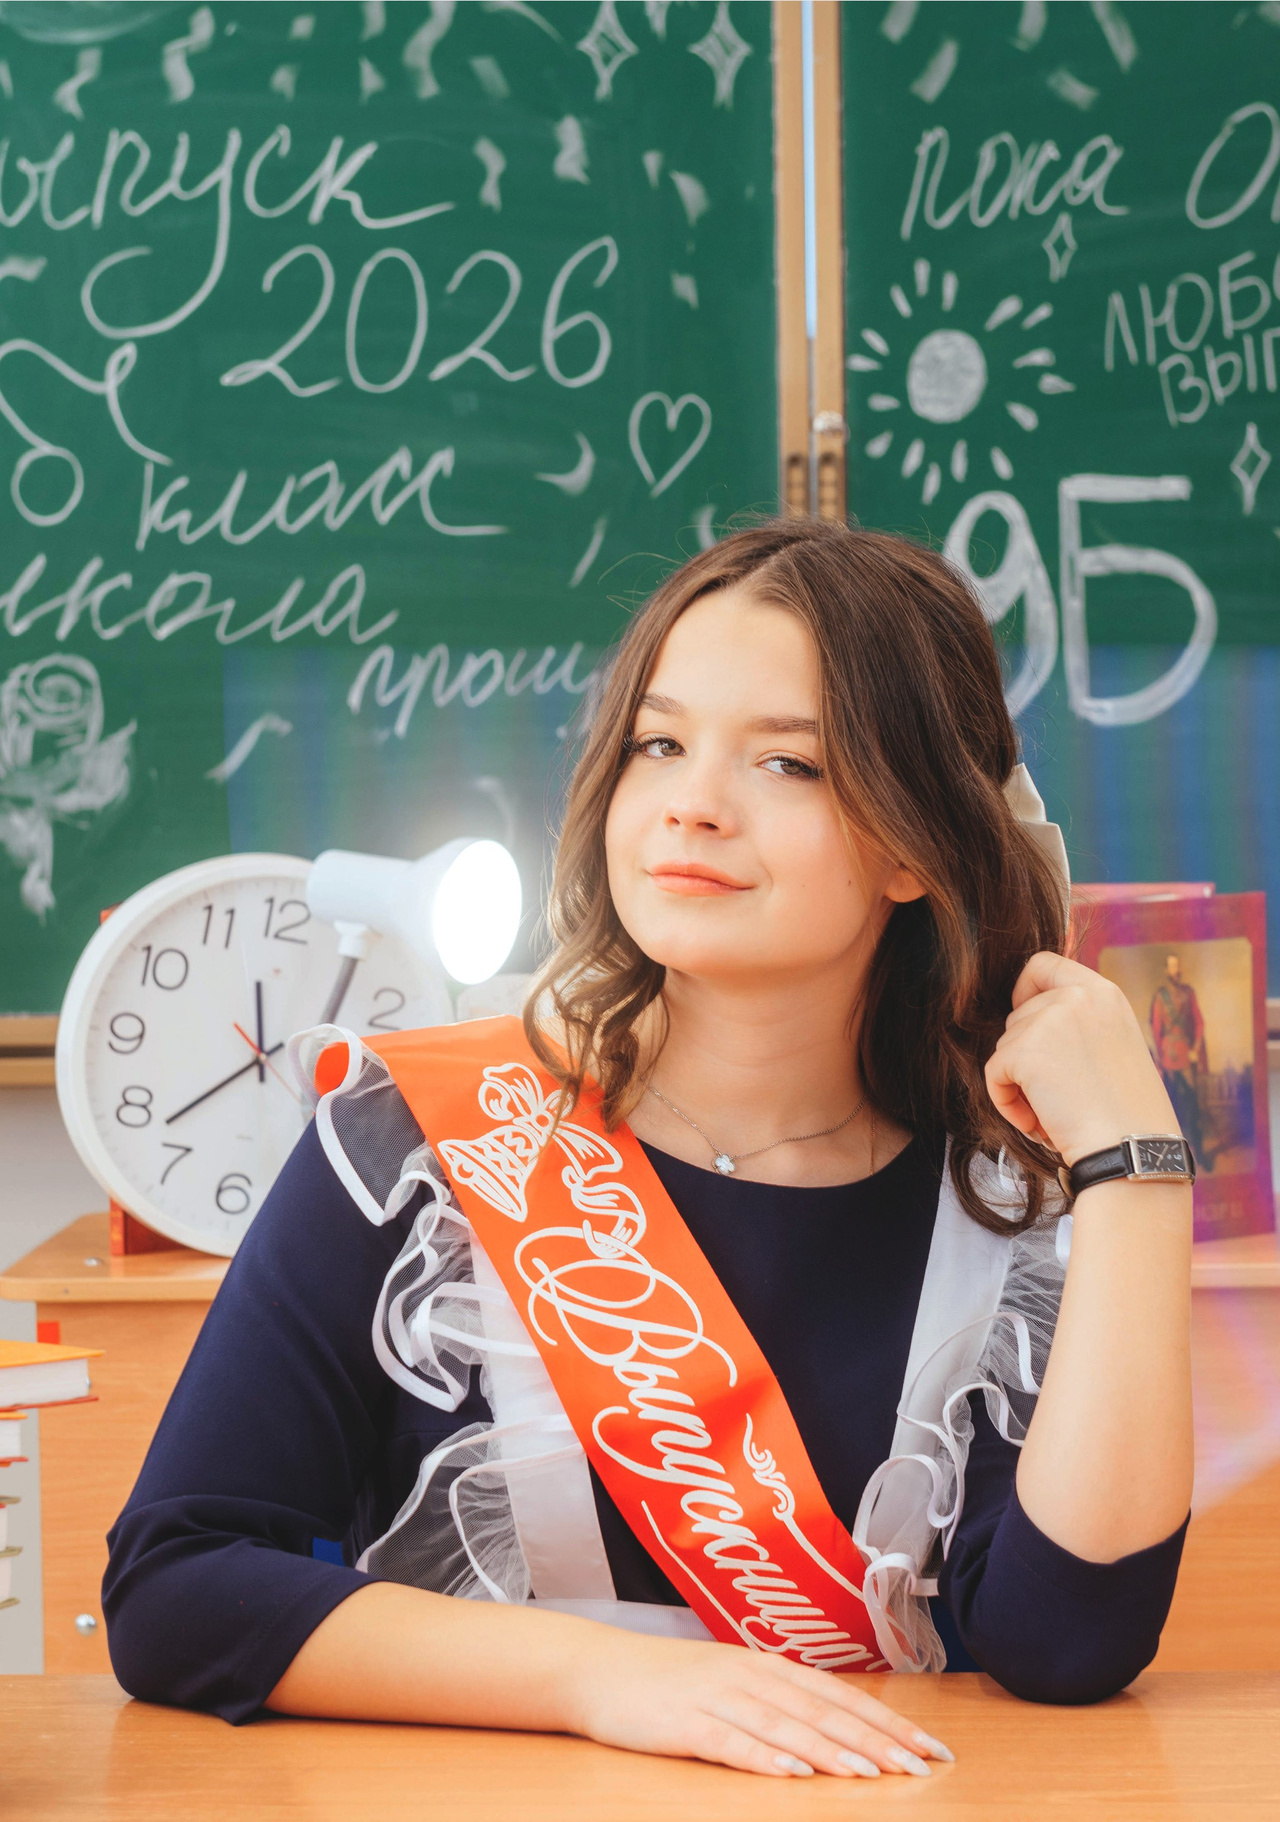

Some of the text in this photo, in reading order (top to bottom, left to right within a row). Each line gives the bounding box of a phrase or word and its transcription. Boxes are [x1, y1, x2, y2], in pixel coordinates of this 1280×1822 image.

[902, 126, 1130, 241] пока
[222, 236, 618, 397] 2026
[202, 905, 237, 950] 11
[264, 897, 312, 945] 12
[140, 945, 190, 991] 10
[366, 987, 407, 1031] 2
[107, 1012, 146, 1056] 9
[115, 1085, 154, 1128] 8
[159, 1143, 194, 1187] 7
[215, 1173, 252, 1215] 6
